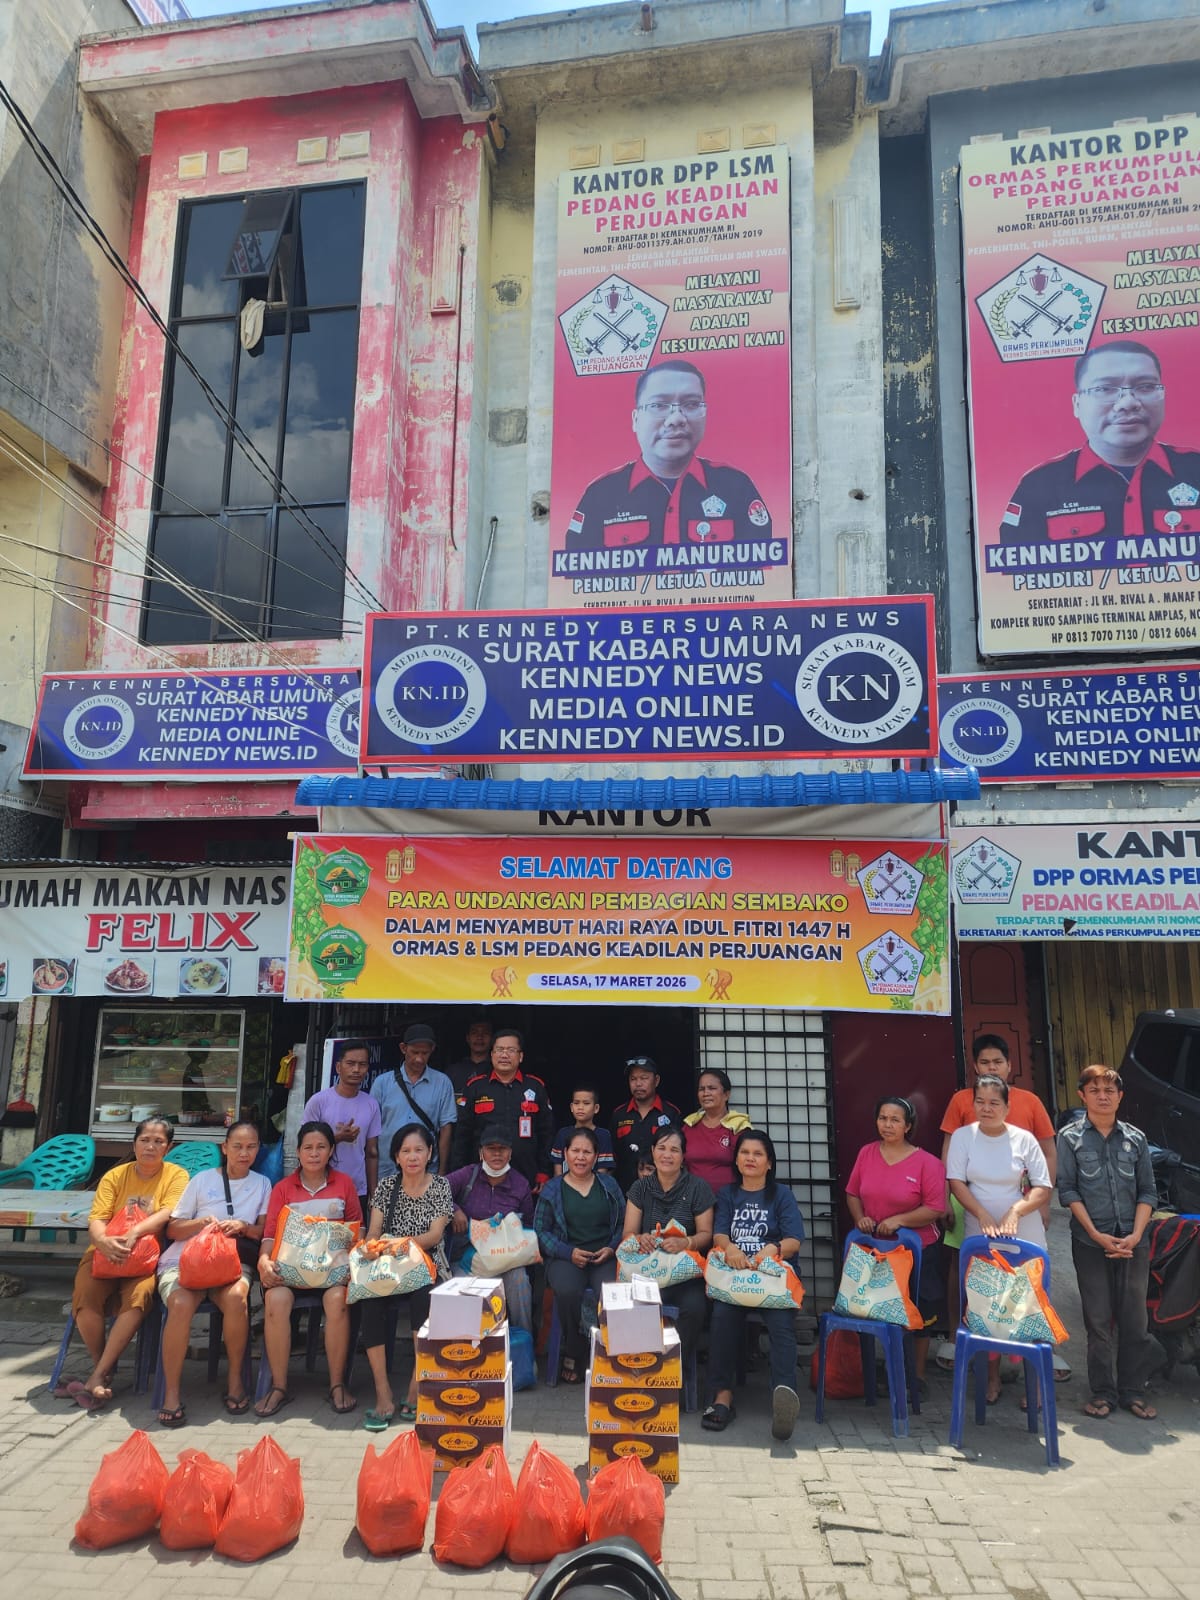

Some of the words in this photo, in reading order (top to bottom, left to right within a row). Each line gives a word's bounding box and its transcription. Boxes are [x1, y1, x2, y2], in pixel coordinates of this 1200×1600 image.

[1010, 134, 1122, 165] KANTOR
[1135, 126, 1189, 150] DPP
[573, 167, 664, 195] KANTOR
[674, 161, 718, 184] DPP
[729, 154, 774, 178] LSM
[968, 167, 1046, 187] ORMAS
[567, 192, 656, 216] PEDANG
[666, 178, 778, 205] KEADILAN
[993, 178, 1082, 199] PEDANG
[1027, 181, 1179, 209] PERJUANGAN
[596, 203, 747, 233] PERJUANGAN
[1026, 209, 1075, 221] TERDAFTAR
[1079, 208, 1088, 216] DI
[1092, 199, 1169, 215] KEMENKUMHAM
[1173, 197, 1182, 205] RI
[607, 232, 648, 244] TERDAFTAR
[650, 231, 658, 239] DI
[661, 225, 724, 239] KEMENKUMHAM
[997, 222, 1036, 233] NOMOR:
[584, 245, 615, 255] NOMOR:
[743, 229, 763, 239] 2019
[685, 270, 760, 290] MELAYANI
[673, 290, 773, 312] MASYARAKAT
[690, 313, 749, 331] ADALAH
[1102, 312, 1199, 335] KESUKAAN
[660, 333, 739, 354] KESUKAAN
[744, 331, 784, 347] KAMI
[581, 361, 643, 373] PERJUANGAN
[555, 548, 648, 572] KENNEDY
[656, 541, 783, 567] MANURUNG
[988, 540, 1106, 568] KENNEDY
[573, 575, 637, 594] PENDIRI
[640, 574, 651, 594] /
[655, 570, 705, 590] KETUA
[711, 569, 764, 587] UMUM
[1013, 570, 1093, 591] PENDIRI
[1099, 569, 1112, 589] /
[1117, 564, 1181, 584] KETUA
[1028, 596, 1082, 610] SEKRETARIAT
[1102, 595, 1118, 606] KH.
[1120, 593, 1145, 605] RIVAL
[1163, 591, 1195, 602] MANAF
[620, 615, 788, 635] BERSUARA
[811, 611, 900, 629] NEWS
[990, 616, 1030, 630] KOMPLEK
[1032, 615, 1055, 627] RUKO
[1057, 613, 1100, 626] SAMPING
[1102, 611, 1146, 624] TERMINAL
[1148, 609, 1187, 622] AMPLAS,
[1051, 632, 1063, 644] HP
[1066, 631, 1088, 643] 0813
[1091, 630, 1113, 641] 7070
[1116, 629, 1138, 640] 7130
[1149, 627, 1172, 639] 0812
[1174, 626, 1197, 638] 6064
[483, 640, 579, 663] SURAT
[589, 637, 690, 661] KABAR
[700, 634, 801, 659] UMUM
[391, 649, 429, 673] MEDIA
[433, 648, 476, 674] ONLINE
[802, 649, 831, 690] SURAT
[833, 638, 885, 652] KABAR
[888, 648, 917, 688] UMUM
[221, 674, 349, 687] BERSUARA
[521, 665, 665, 689] KENNEDY
[673, 662, 763, 687] NEWS
[136, 690, 197, 706] SURAT
[201, 689, 264, 705] KABAR
[269, 688, 334, 703] UMUM
[402, 685, 466, 701] KN.ID
[826, 673, 892, 702] KN
[1017, 691, 1089, 708] SURAT
[1096, 688, 1174, 705] KABAR
[157, 707, 248, 723] KENNEDY
[253, 706, 308, 721] NEWS
[529, 697, 627, 720] MEDIA
[636, 694, 754, 719] ONLINE
[949, 702, 976, 718] MEDIA
[1047, 707, 1154, 726] KENNEDY
[80, 721, 121, 732] KN.ID
[386, 706, 432, 742] KENNEDY
[435, 706, 477, 741] NEWS.ID
[806, 707, 871, 739] KENNEDY
[875, 705, 912, 736] NEWS
[960, 726, 1007, 737] KN.ID
[159, 726, 221, 742] MEDIA
[227, 725, 300, 741] ONLINE
[500, 726, 643, 750] KENNEDY
[652, 724, 785, 748] NEWS.ID
[1055, 729, 1129, 746] MEDIA
[138, 746, 230, 762] KENNEDY
[234, 744, 318, 761] NEWS.ID
[1034, 749, 1142, 767] KENNEDY
[538, 808, 712, 827] KANTOR
[500, 856, 619, 880] SELAMAT
[627, 857, 733, 880] DATANG
[1033, 869, 1075, 886] DPP
[1079, 868, 1165, 886] ORMAS
[93, 877, 210, 907] MAKAN
[223, 876, 286, 906] NAS
[388, 891, 449, 910] PARA
[455, 891, 587, 910] UNDANGAN
[591, 891, 728, 911] PEMBAGIAN
[731, 892, 848, 913] SEMBAKO
[1022, 893, 1102, 912] PEDANG
[86, 911, 260, 951] FELIX
[385, 918, 450, 935] DALAM
[456, 919, 574, 936] MENYAMBUT
[579, 919, 623, 936] HARI
[629, 920, 678, 936] RAYA
[684, 920, 728, 937] IDUL
[734, 921, 782, 938] FITRI
[787, 921, 831, 939] 1447
[837, 923, 850, 939] H
[996, 916, 1056, 925] TERDAFTAR
[1158, 916, 1168, 924] RI
[1022, 929, 1064, 937] KANTOR
[1105, 929, 1181, 937] PERKUMPULAN
[392, 940, 459, 957] ORMAS
[464, 941, 477, 956] &
[482, 941, 518, 956] LSM
[523, 941, 601, 957] PEDANG
[606, 941, 704, 958] KEADILAN
[709, 942, 843, 961] PERJUANGAN
[541, 975, 591, 988] SELASA,
[595, 975, 605, 986] 17
[609, 975, 652, 987] MARET
[656, 976, 687, 987] 2026
[733, 1209, 769, 1221] LOVE
[731, 1285, 765, 1294] GoGreen
